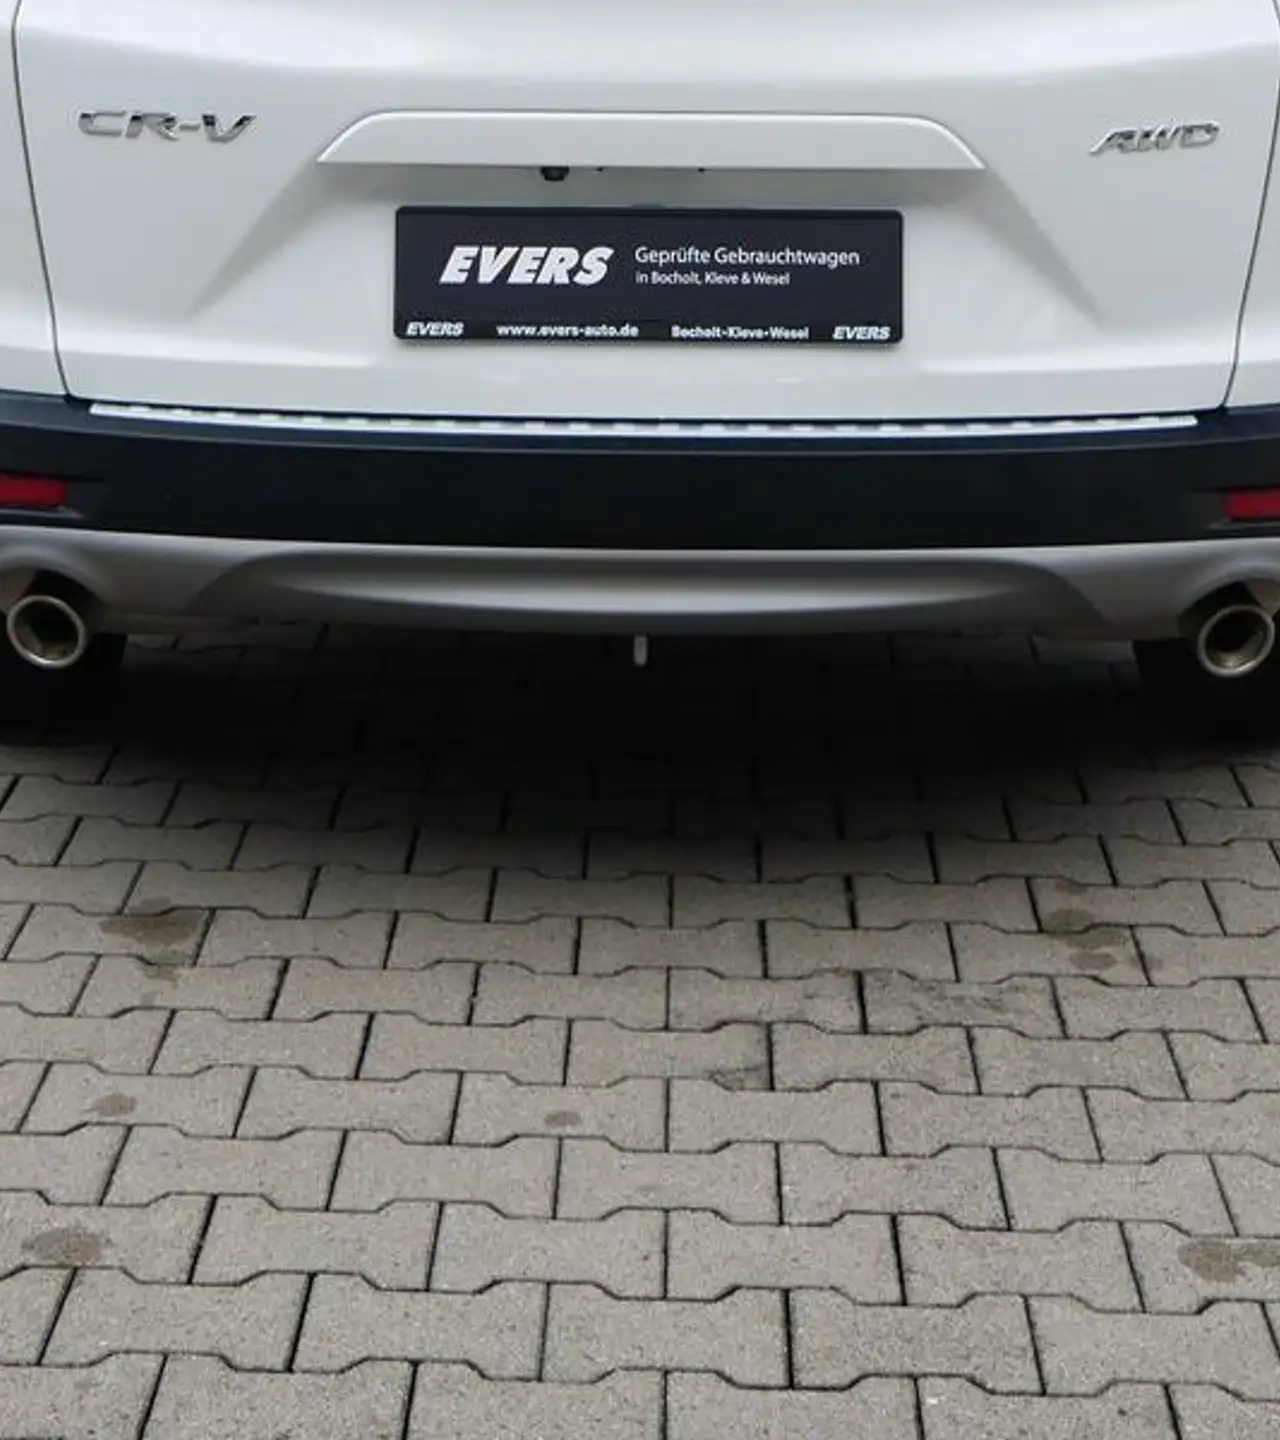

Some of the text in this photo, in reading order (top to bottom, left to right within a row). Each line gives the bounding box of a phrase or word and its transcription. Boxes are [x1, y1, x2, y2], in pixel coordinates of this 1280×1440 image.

[77, 111, 257, 143] CR-V
[1089, 120, 1219, 155] AWD
[439, 245, 615, 286] EVERS
[634, 246, 860, 269] Geprüfte Gebrauchtwagen
[635, 271, 790, 286] in Bocholt, Kleve & Wesel
[406, 321, 464, 336] EVERS
[496, 323, 639, 337] www.evers-auto.de
[832, 326, 891, 340] EVERS
